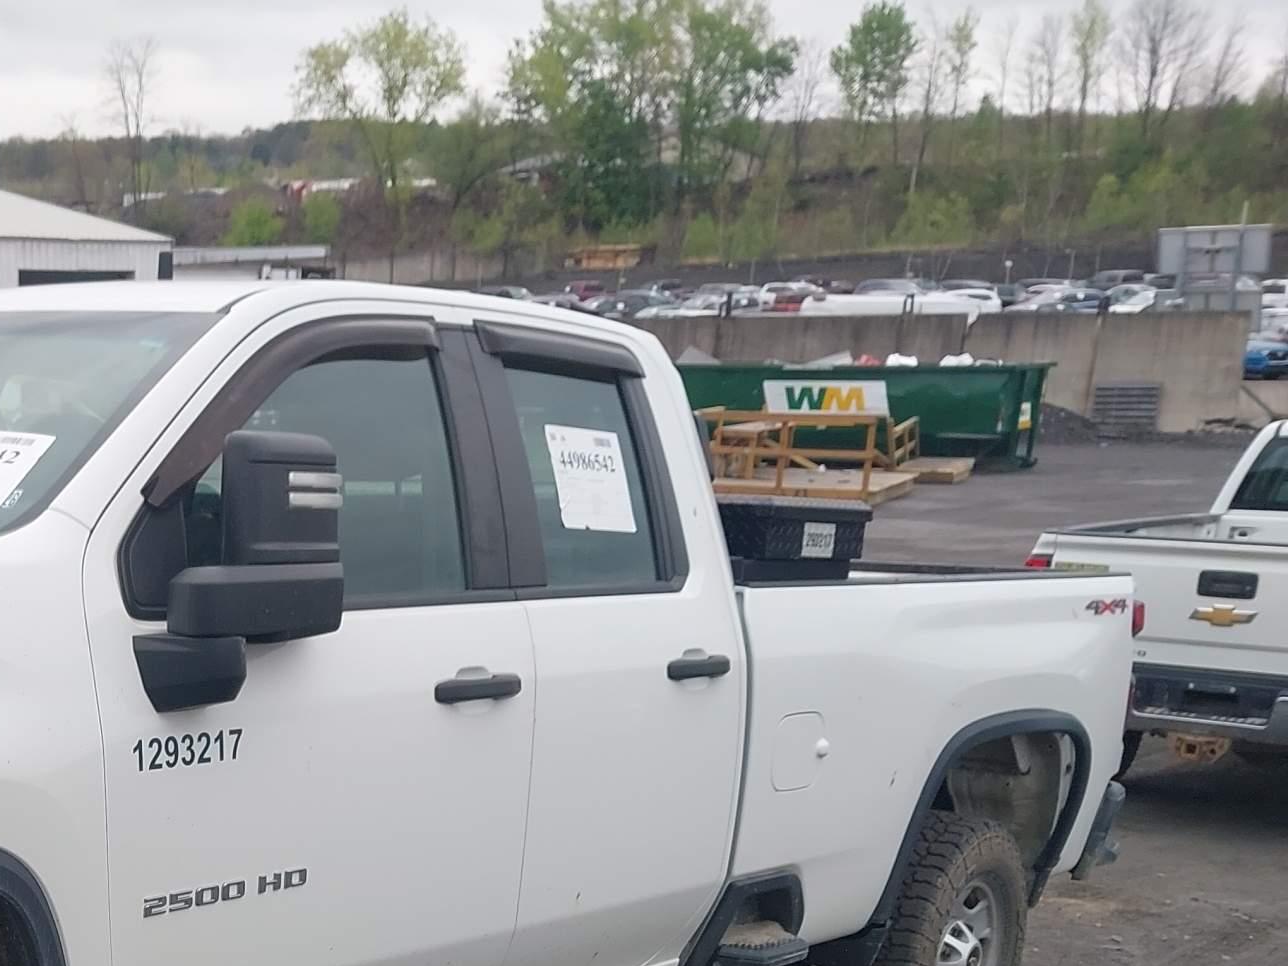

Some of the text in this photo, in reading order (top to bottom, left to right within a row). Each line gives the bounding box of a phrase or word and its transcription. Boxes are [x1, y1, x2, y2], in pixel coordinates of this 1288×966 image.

[785, 387, 864, 411] WM
[560, 450, 616, 473] 44986542
[132, 728, 243, 772] 1293217
[143, 868, 307, 918] 2500 HD
